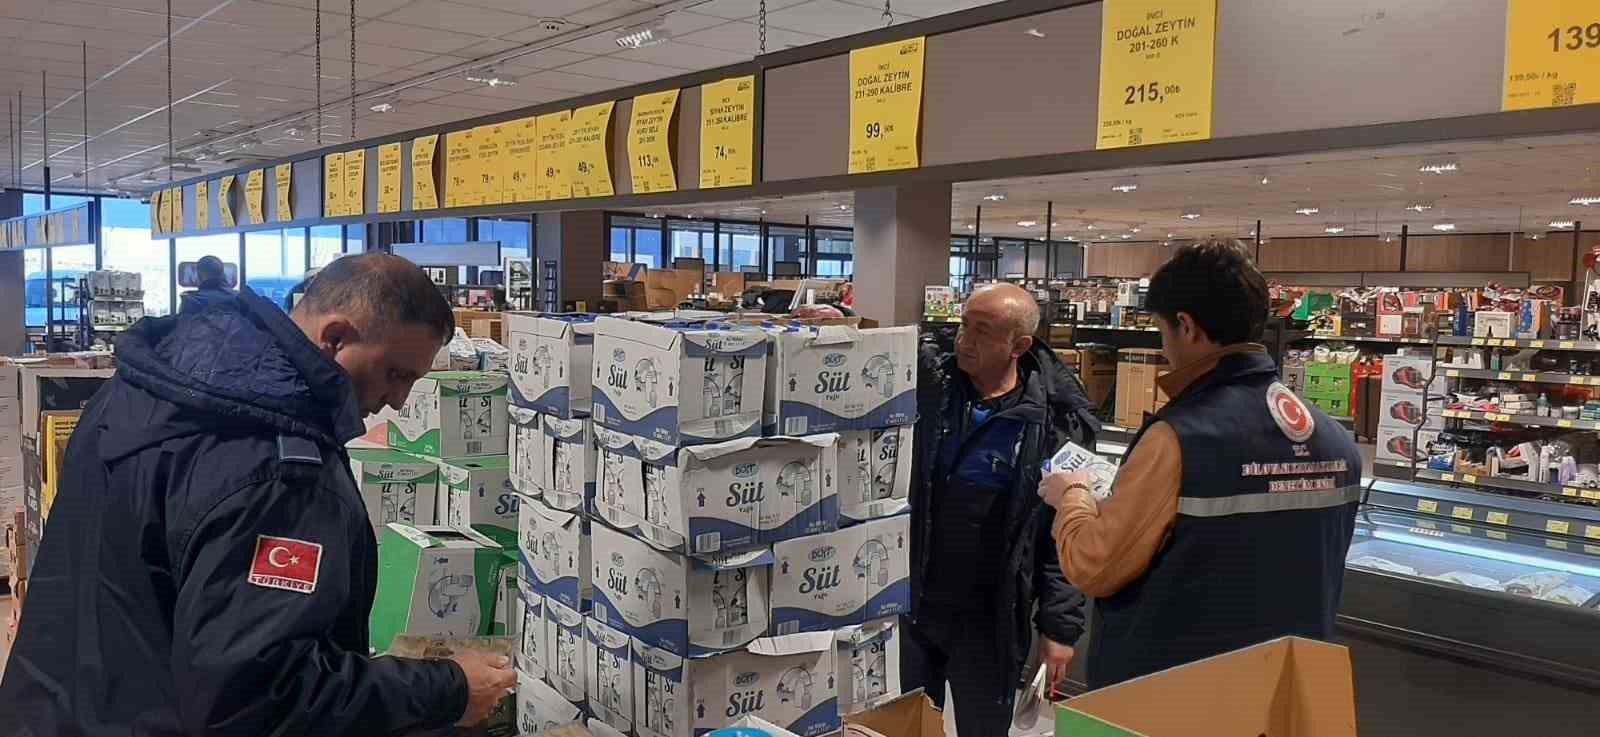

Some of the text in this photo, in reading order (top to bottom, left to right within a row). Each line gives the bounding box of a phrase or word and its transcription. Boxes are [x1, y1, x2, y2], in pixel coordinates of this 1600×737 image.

[1117, 17, 1195, 41] DOĞAL ZEYTİN
[1129, 36, 1178, 53] 201-260 K
[857, 70, 910, 86] DOĞAL ZEYTİN
[880, 82, 912, 95] KALİBRE
[608, 364, 629, 389] Süt
[814, 371, 850, 393] Süt
[726, 482, 765, 507] Süt
[607, 567, 628, 595] Süt
[799, 564, 841, 593] Süt
[726, 691, 763, 717] Süt
